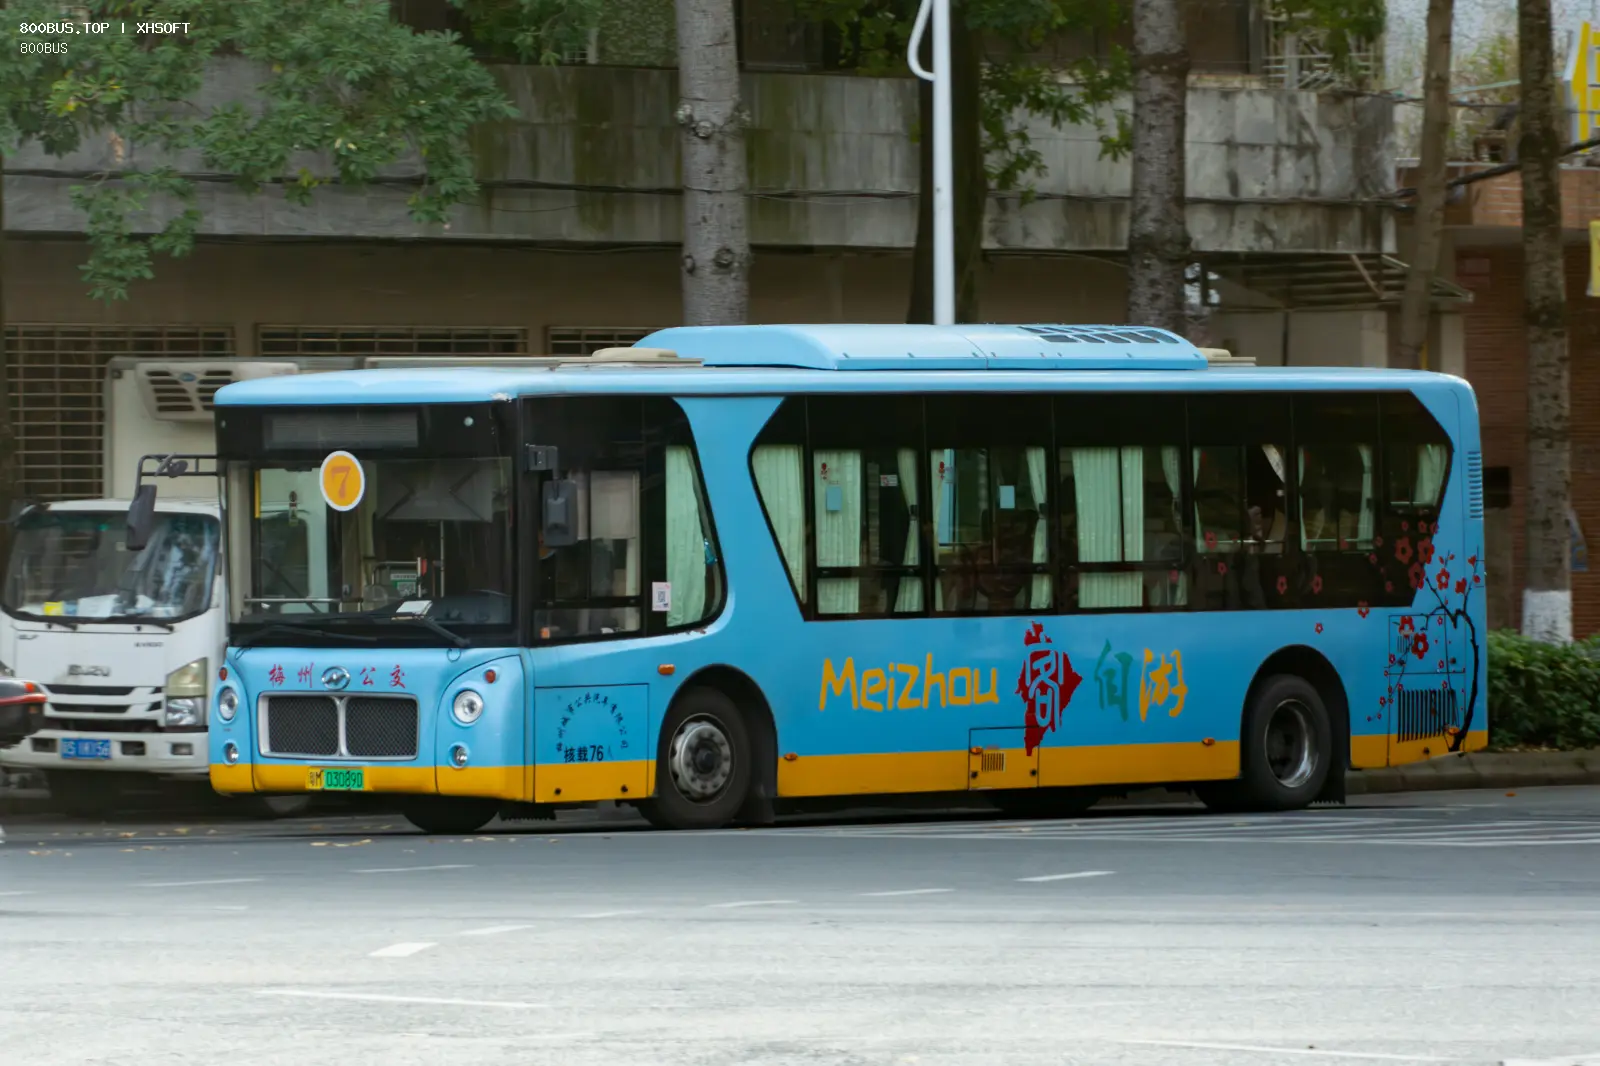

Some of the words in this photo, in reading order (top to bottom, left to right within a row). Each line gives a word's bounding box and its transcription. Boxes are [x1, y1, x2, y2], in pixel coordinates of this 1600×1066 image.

[331, 466, 351, 499] 7
[268, 662, 315, 688] 梅州
[359, 664, 406, 689] 公交
[819, 652, 1000, 713] Meizhou
